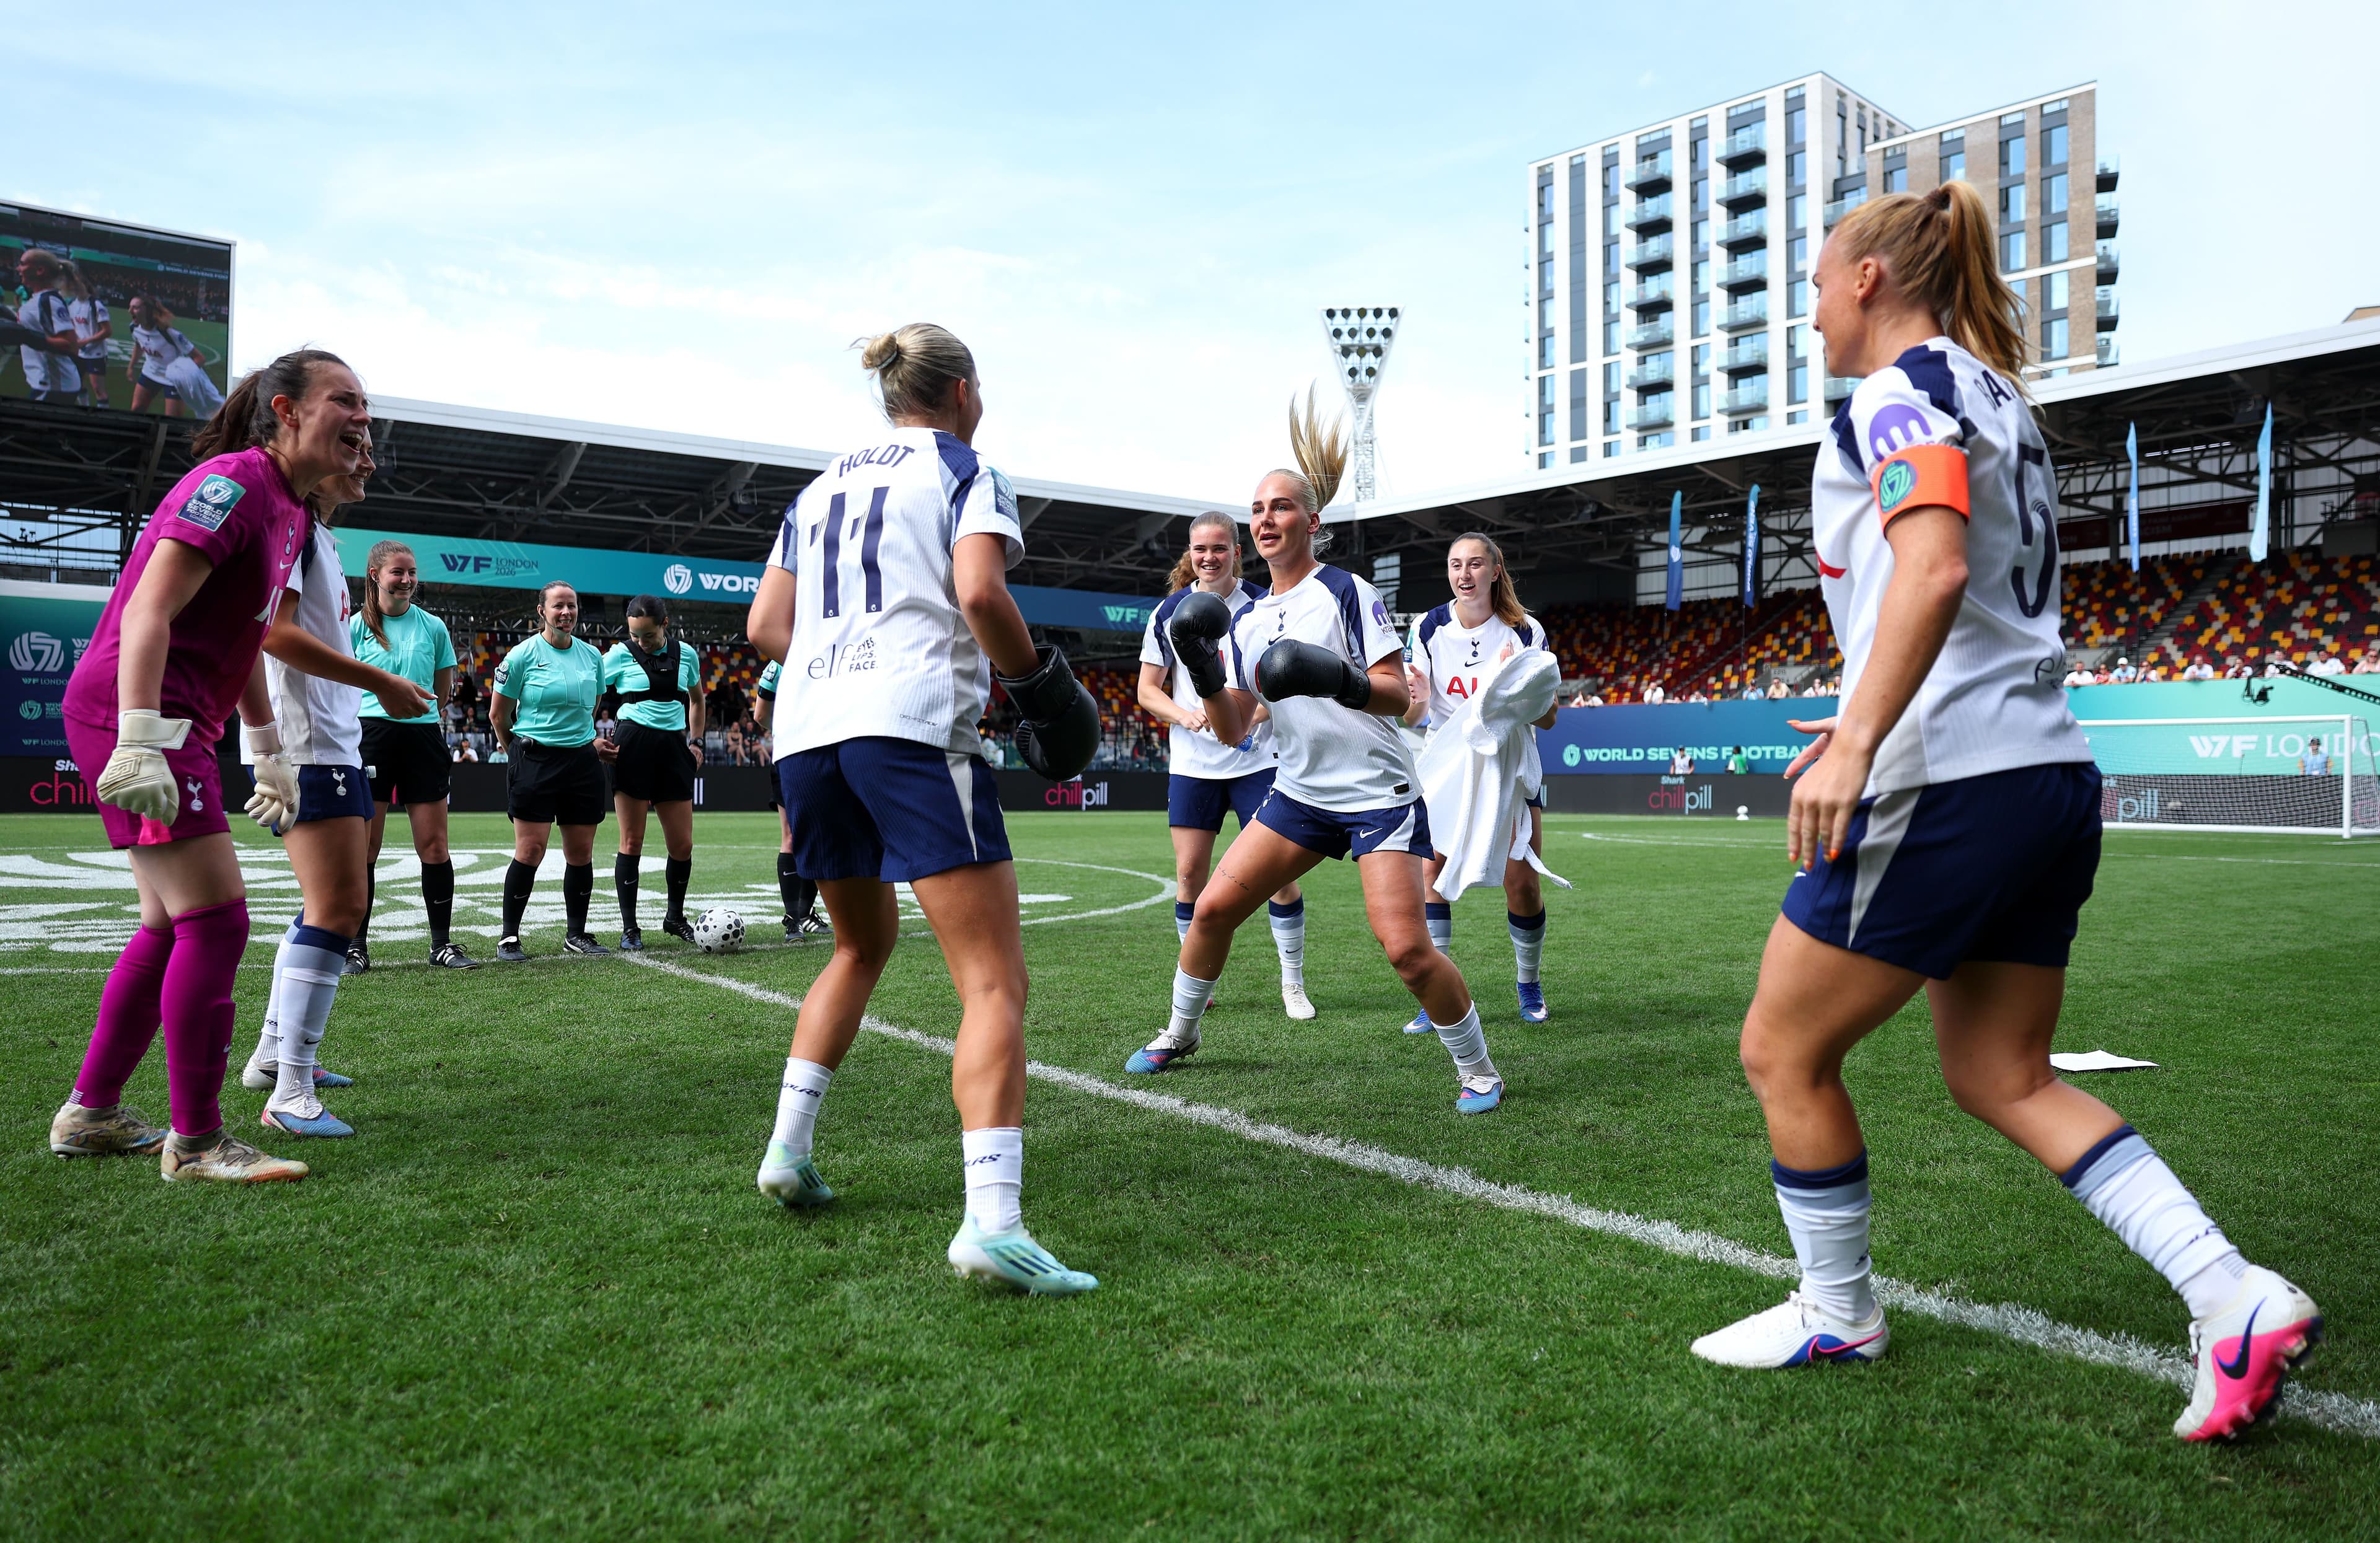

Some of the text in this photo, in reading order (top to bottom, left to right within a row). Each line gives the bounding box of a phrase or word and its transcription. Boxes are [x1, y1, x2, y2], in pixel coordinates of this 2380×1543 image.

[839, 444, 915, 478] HOLDT
[187, 503, 222, 521] SEVENS
[187, 508, 218, 524] FOOTBALL
[192, 499, 223, 516] WORLD
[2011, 442, 2056, 618] 5
[809, 486, 890, 618] 11
[495, 568, 516, 576] 2026
[496, 558, 539, 569] LONDON
[699, 573, 762, 593] WOR
[1447, 676, 1478, 700] AI
[1584, 747, 1644, 762] WORLD
[2266, 733, 2380, 758] LONDO
[1661, 775, 1685, 785] Shark
[1649, 784, 1712, 815] chillpill
